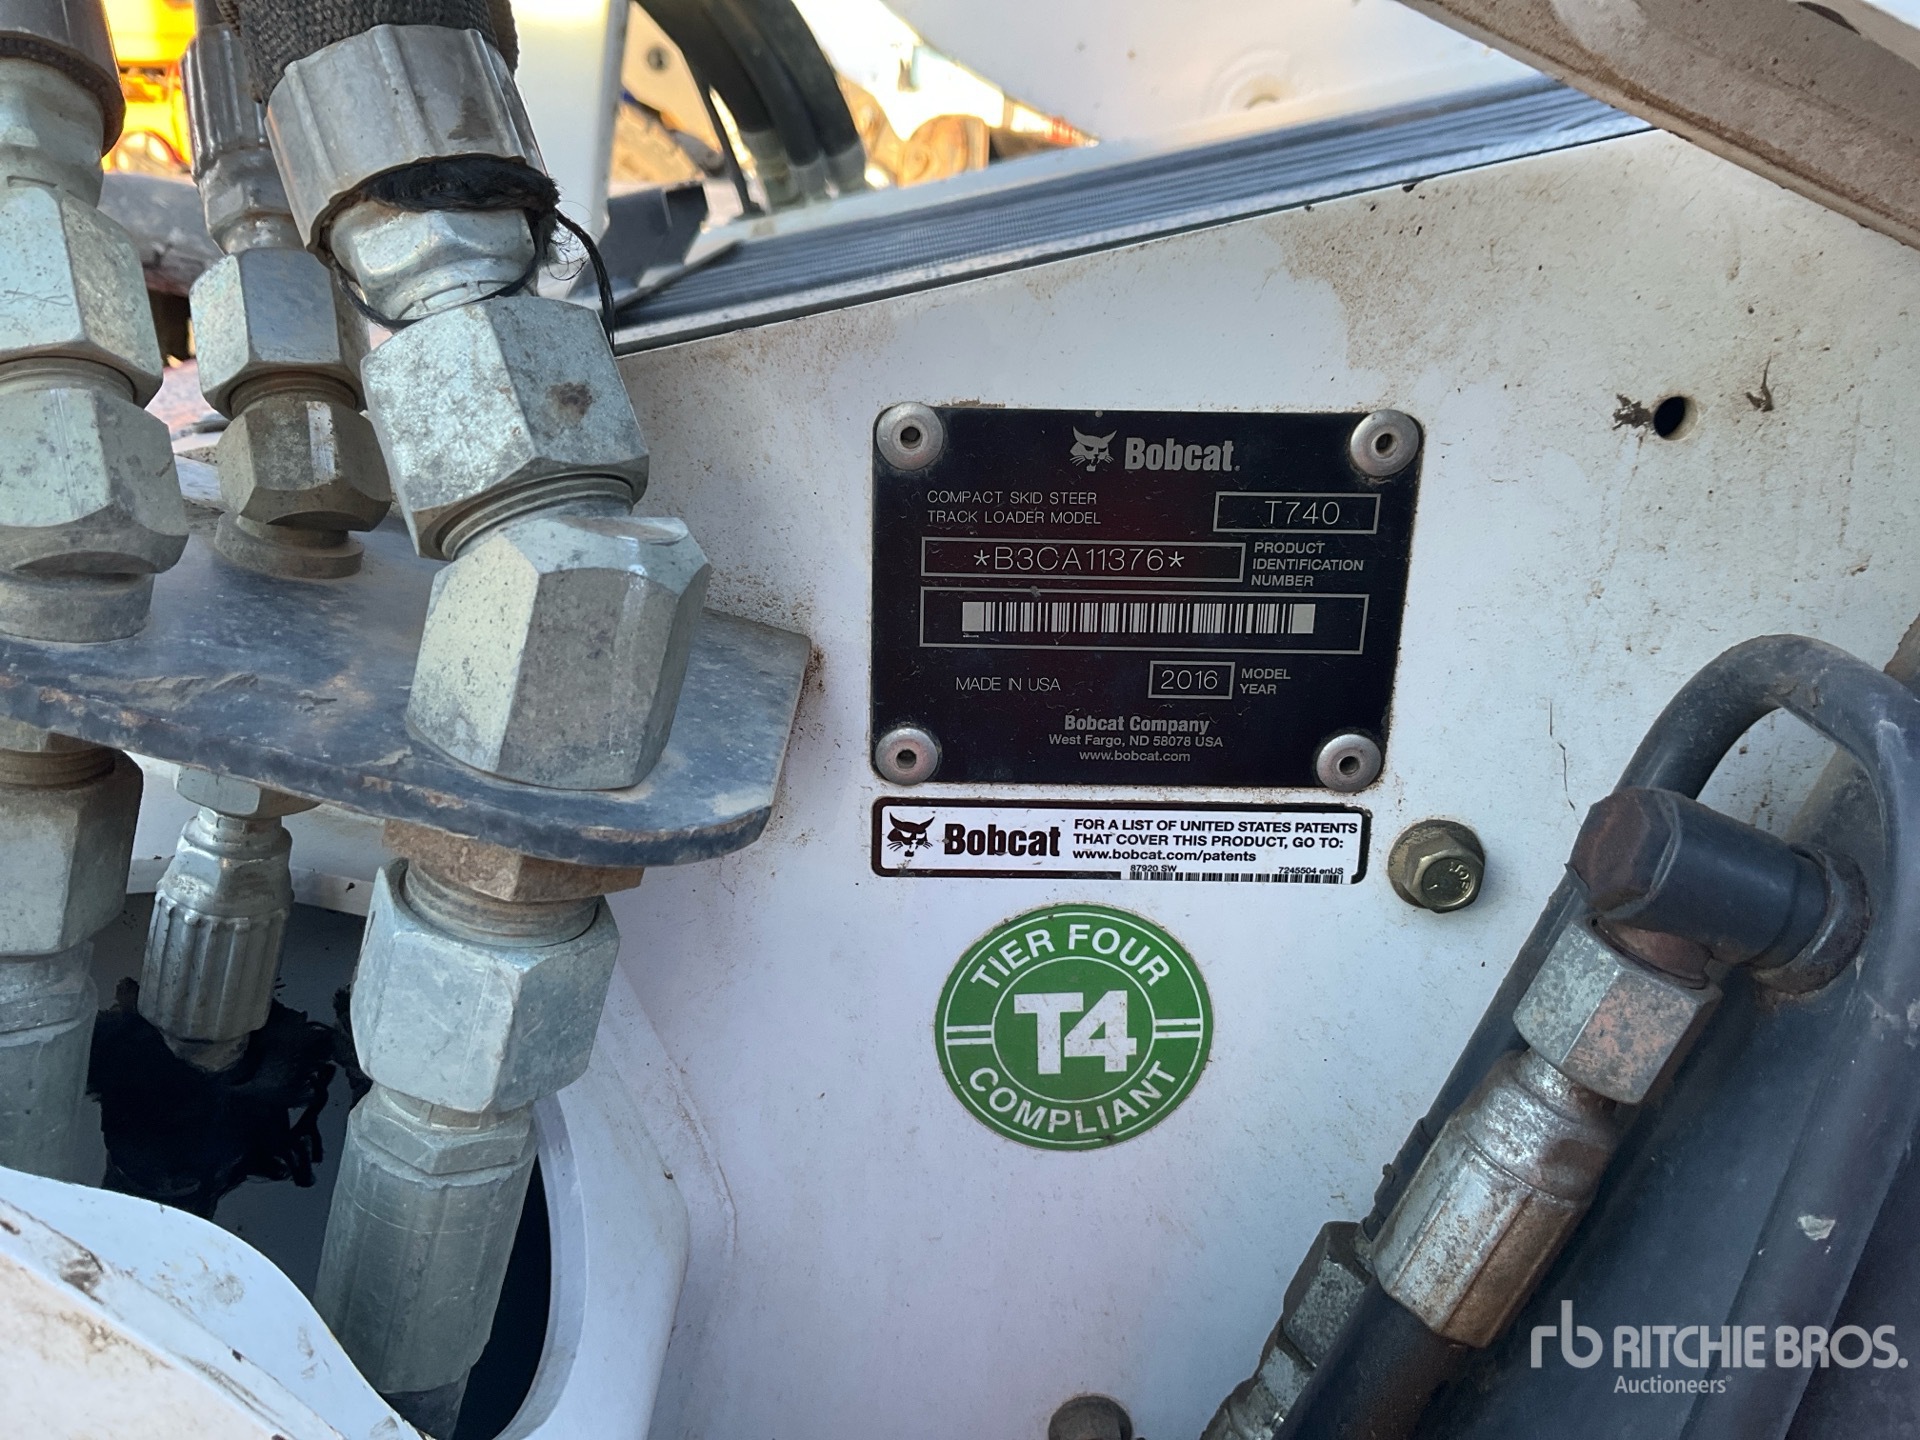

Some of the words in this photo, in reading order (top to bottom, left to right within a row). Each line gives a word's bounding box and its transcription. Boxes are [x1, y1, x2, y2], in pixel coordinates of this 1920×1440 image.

[926, 489, 1003, 504] COMPACT
[1009, 491, 1043, 505] SKID
[1050, 491, 1097, 505] STEER
[927, 509, 978, 523] TRACK
[984, 510, 1045, 524] LOADER
[1050, 511, 1101, 525] MODEL
[1264, 500, 1340, 525] T740
[1254, 541, 1325, 554] PRODUCT
[1252, 558, 1364, 571] IDENTIFICATION
[1251, 574, 1314, 587] NUMBER
[1160, 669, 1218, 690] 2016
[1241, 668, 1291, 680] MODEL
[955, 676, 1001, 691] MADE
[1008, 677, 1022, 691] IN
[1028, 677, 1061, 692] USA
[1240, 683, 1277, 695] YEAR
[1064, 714, 1124, 731] Bobcat
[1129, 716, 1210, 735] Company
[1049, 733, 1081, 745] West
[1084, 734, 1126, 748] Fargo,
[1129, 735, 1149, 746] ND
[1153, 736, 1191, 747] 58078
[1195, 736, 1223, 747] USA
[1079, 750, 1191, 762] www.bobcat.com
[1074, 819, 1105, 830] FOR
[1108, 819, 1119, 830] A
[1122, 820, 1153, 831] LIST
[1156, 820, 1177, 831] OF
[1180, 821, 1235, 832] UNITED
[1237, 821, 1291, 833] STATES
[1294, 822, 1358, 834] PATENTS
[944, 823, 1061, 857] Bobcat
[1073, 834, 1112, 845] THAT
[1115, 834, 1169, 846] COVER
[1173, 835, 1207, 846] THIS
[1211, 836, 1288, 849] PRODUCT,
[1292, 837, 1315, 848] GO
[1320, 837, 1344, 849] TO:
[1073, 849, 1257, 862] www.bobcat.com/patents
[1130, 864, 1159, 872] 87920
[1278, 866, 1317, 874] 7245504
[1319, 867, 1344, 875] enUS
[970, 928, 1056, 989] TIER
[1068, 924, 1170, 987] FOUR
[1014, 990, 1137, 1075] T4
[969, 1060, 1176, 1134] COMPLIANT
